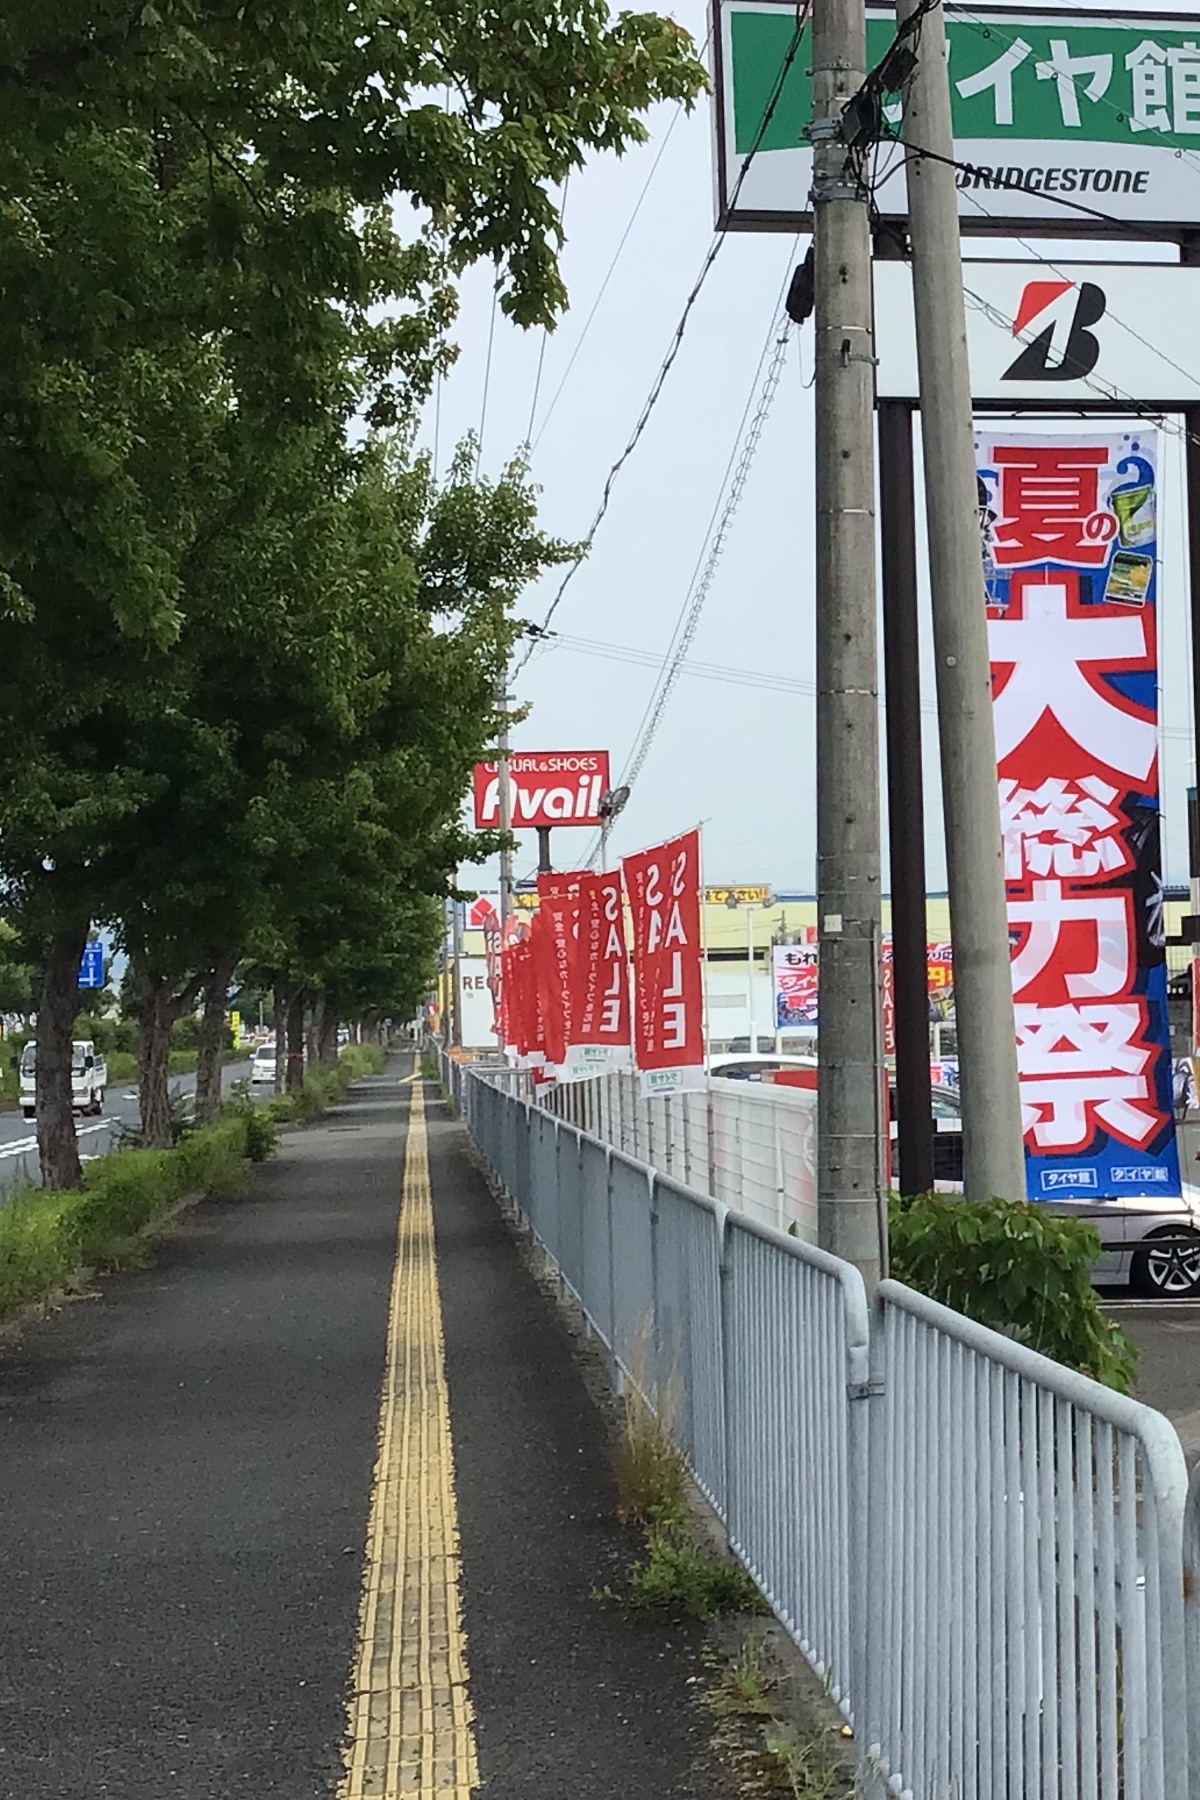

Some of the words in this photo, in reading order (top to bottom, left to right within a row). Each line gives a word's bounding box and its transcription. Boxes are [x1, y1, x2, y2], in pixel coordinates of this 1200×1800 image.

[482, 774, 602, 820] Avail
[1047, 1171, 1091, 1185] タイヤ館
